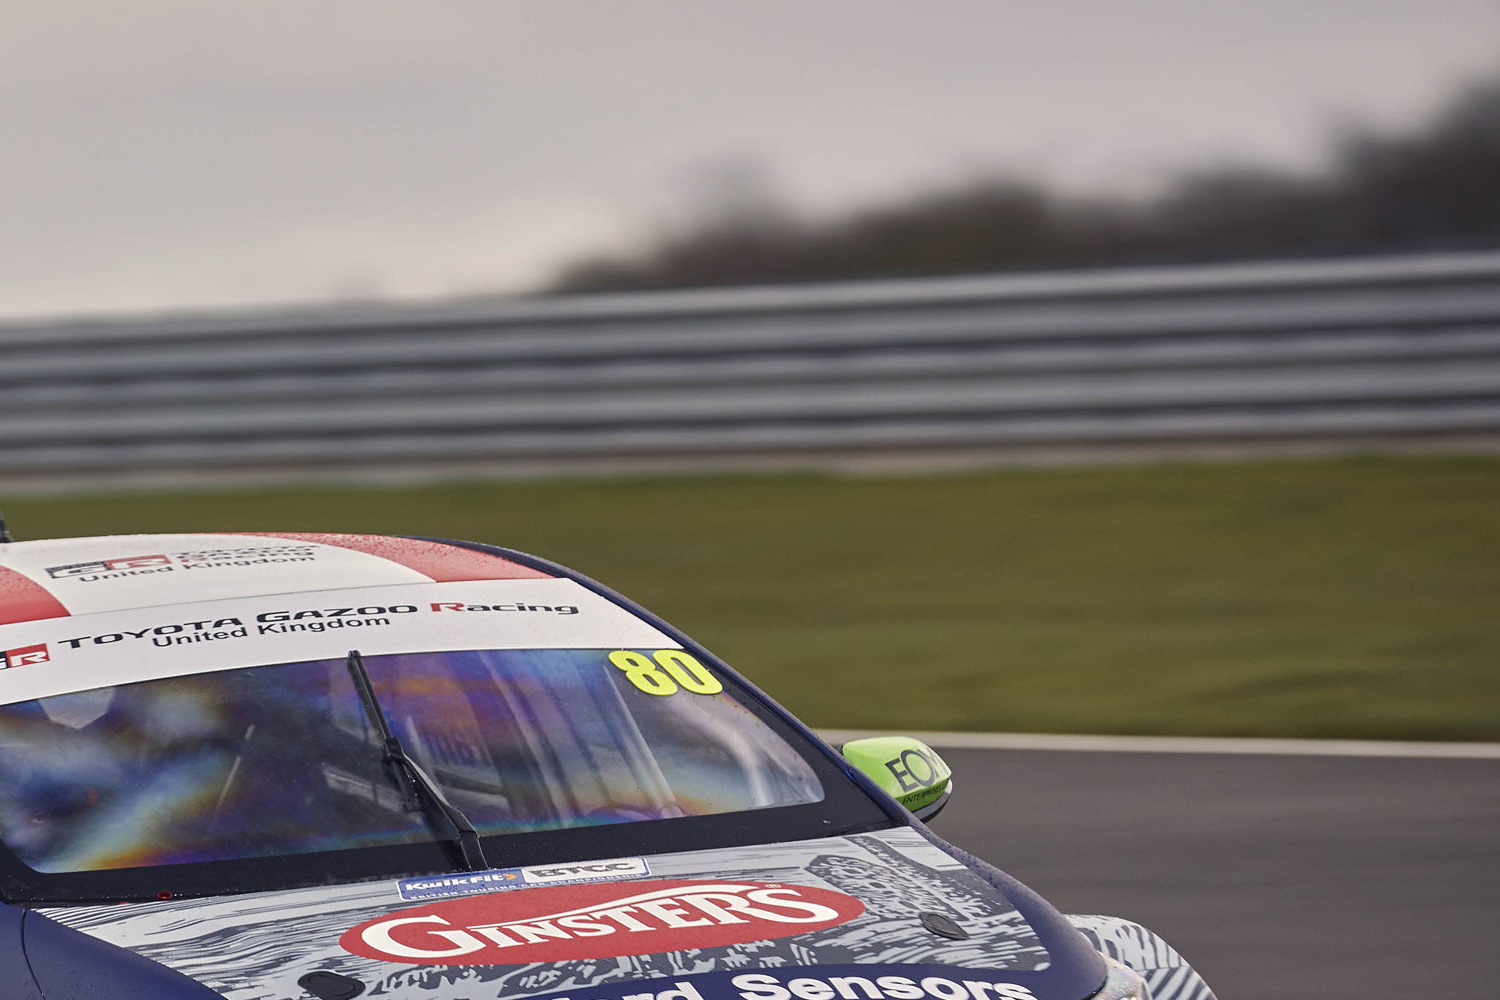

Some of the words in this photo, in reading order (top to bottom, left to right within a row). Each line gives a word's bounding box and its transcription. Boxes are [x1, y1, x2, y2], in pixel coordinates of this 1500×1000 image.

[79, 565, 173, 582] United
[182, 556, 316, 570] Kingdom
[58, 617, 244, 649] TOYOTA
[256, 604, 418, 623] GAZOO
[430, 602, 579, 615] Racing
[152, 626, 248, 647] United
[257, 617, 390, 635] Kingdom
[608, 650, 723, 696] 80
[529, 861, 636, 878] BTCC
[361, 884, 841, 960] GINSTERS
